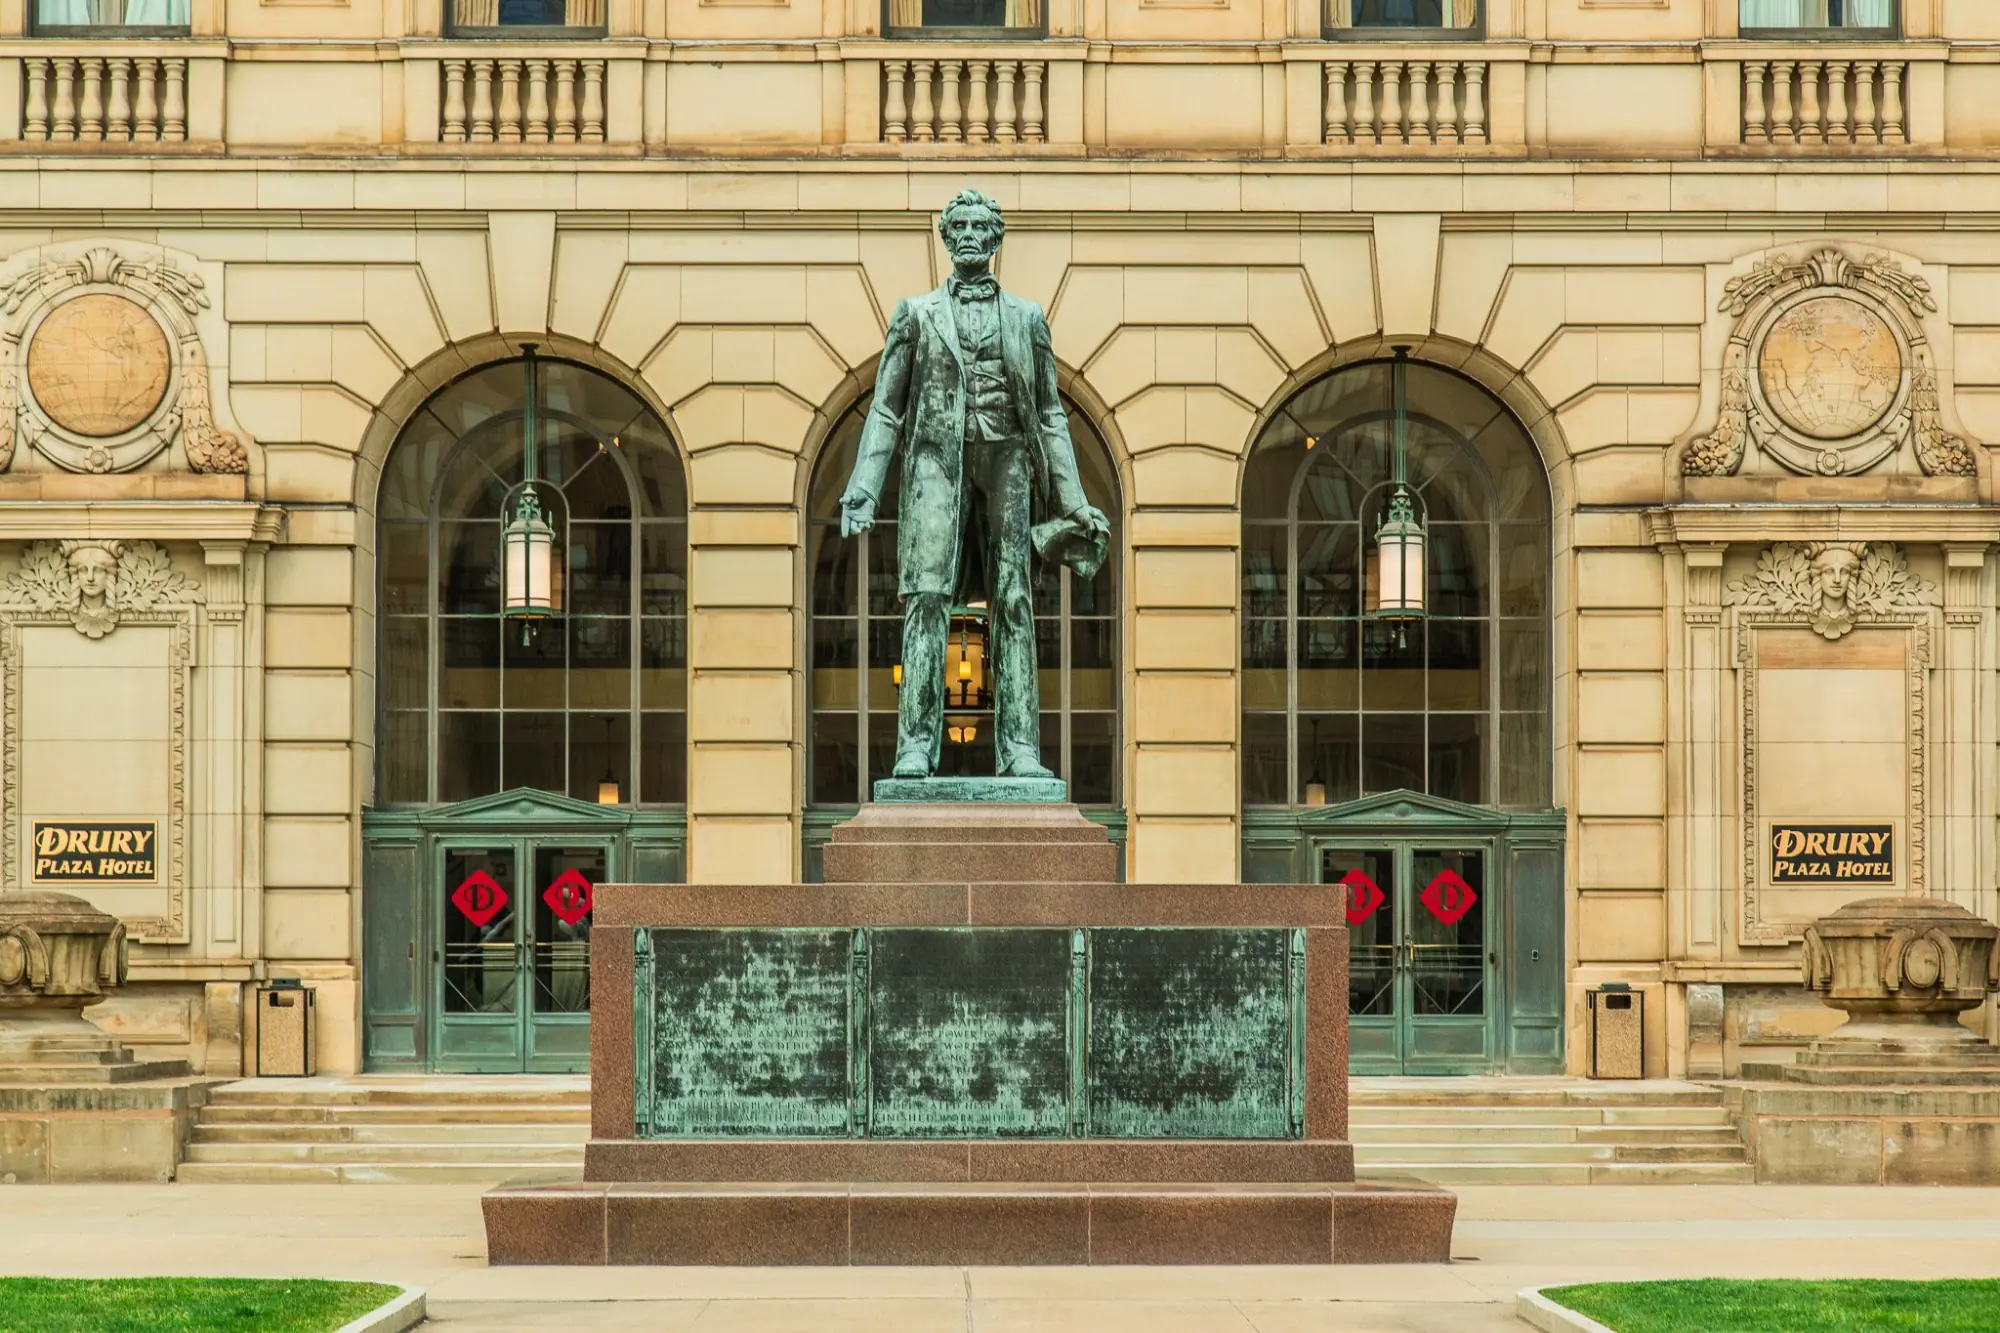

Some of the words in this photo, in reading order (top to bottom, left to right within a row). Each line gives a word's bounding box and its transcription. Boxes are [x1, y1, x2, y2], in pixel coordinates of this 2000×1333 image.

[36, 827, 153, 856] DRURY
[1774, 830, 1891, 857] DRURY
[36, 858, 94, 875] PLAZA
[98, 858, 153, 876] HOTEL
[1774, 861, 1831, 878] PLAZA
[1836, 861, 1891, 878] HOTEL
[464, 884, 495, 912] D
[555, 882, 586, 910] D
[1346, 884, 1371, 910] D
[1431, 883, 1464, 910] D
[938, 1029, 978, 1038] POWER
[944, 1041, 987, 1050] WORL
